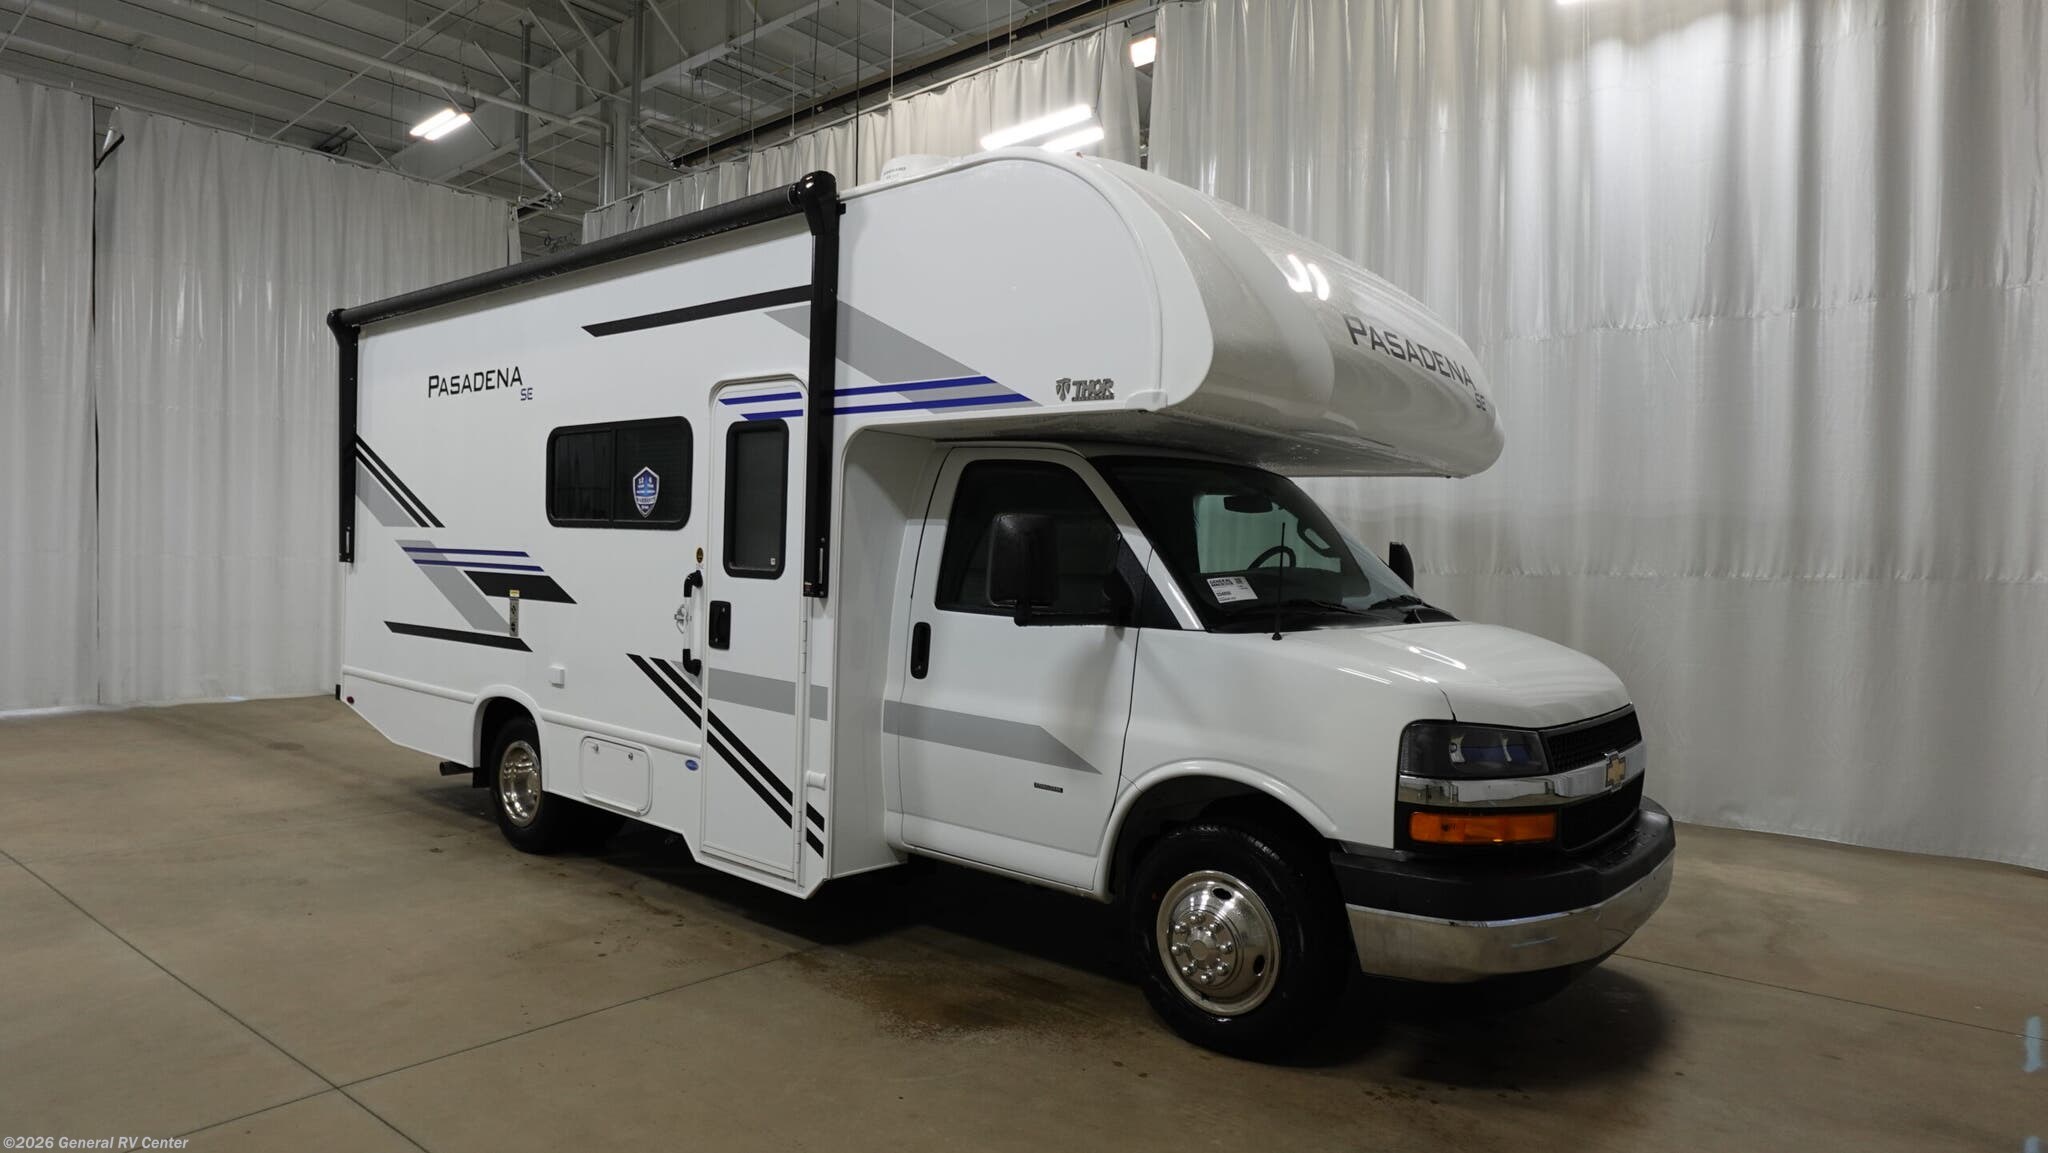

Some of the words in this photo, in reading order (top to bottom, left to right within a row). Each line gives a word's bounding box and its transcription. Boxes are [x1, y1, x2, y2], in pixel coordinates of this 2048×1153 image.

[1343, 314, 1477, 391] PASADENA
[1474, 392, 1487, 411] SE
[428, 366, 523, 398] PASADENA
[520, 387, 533, 401] SE
[1072, 378, 1114, 400] THOR
